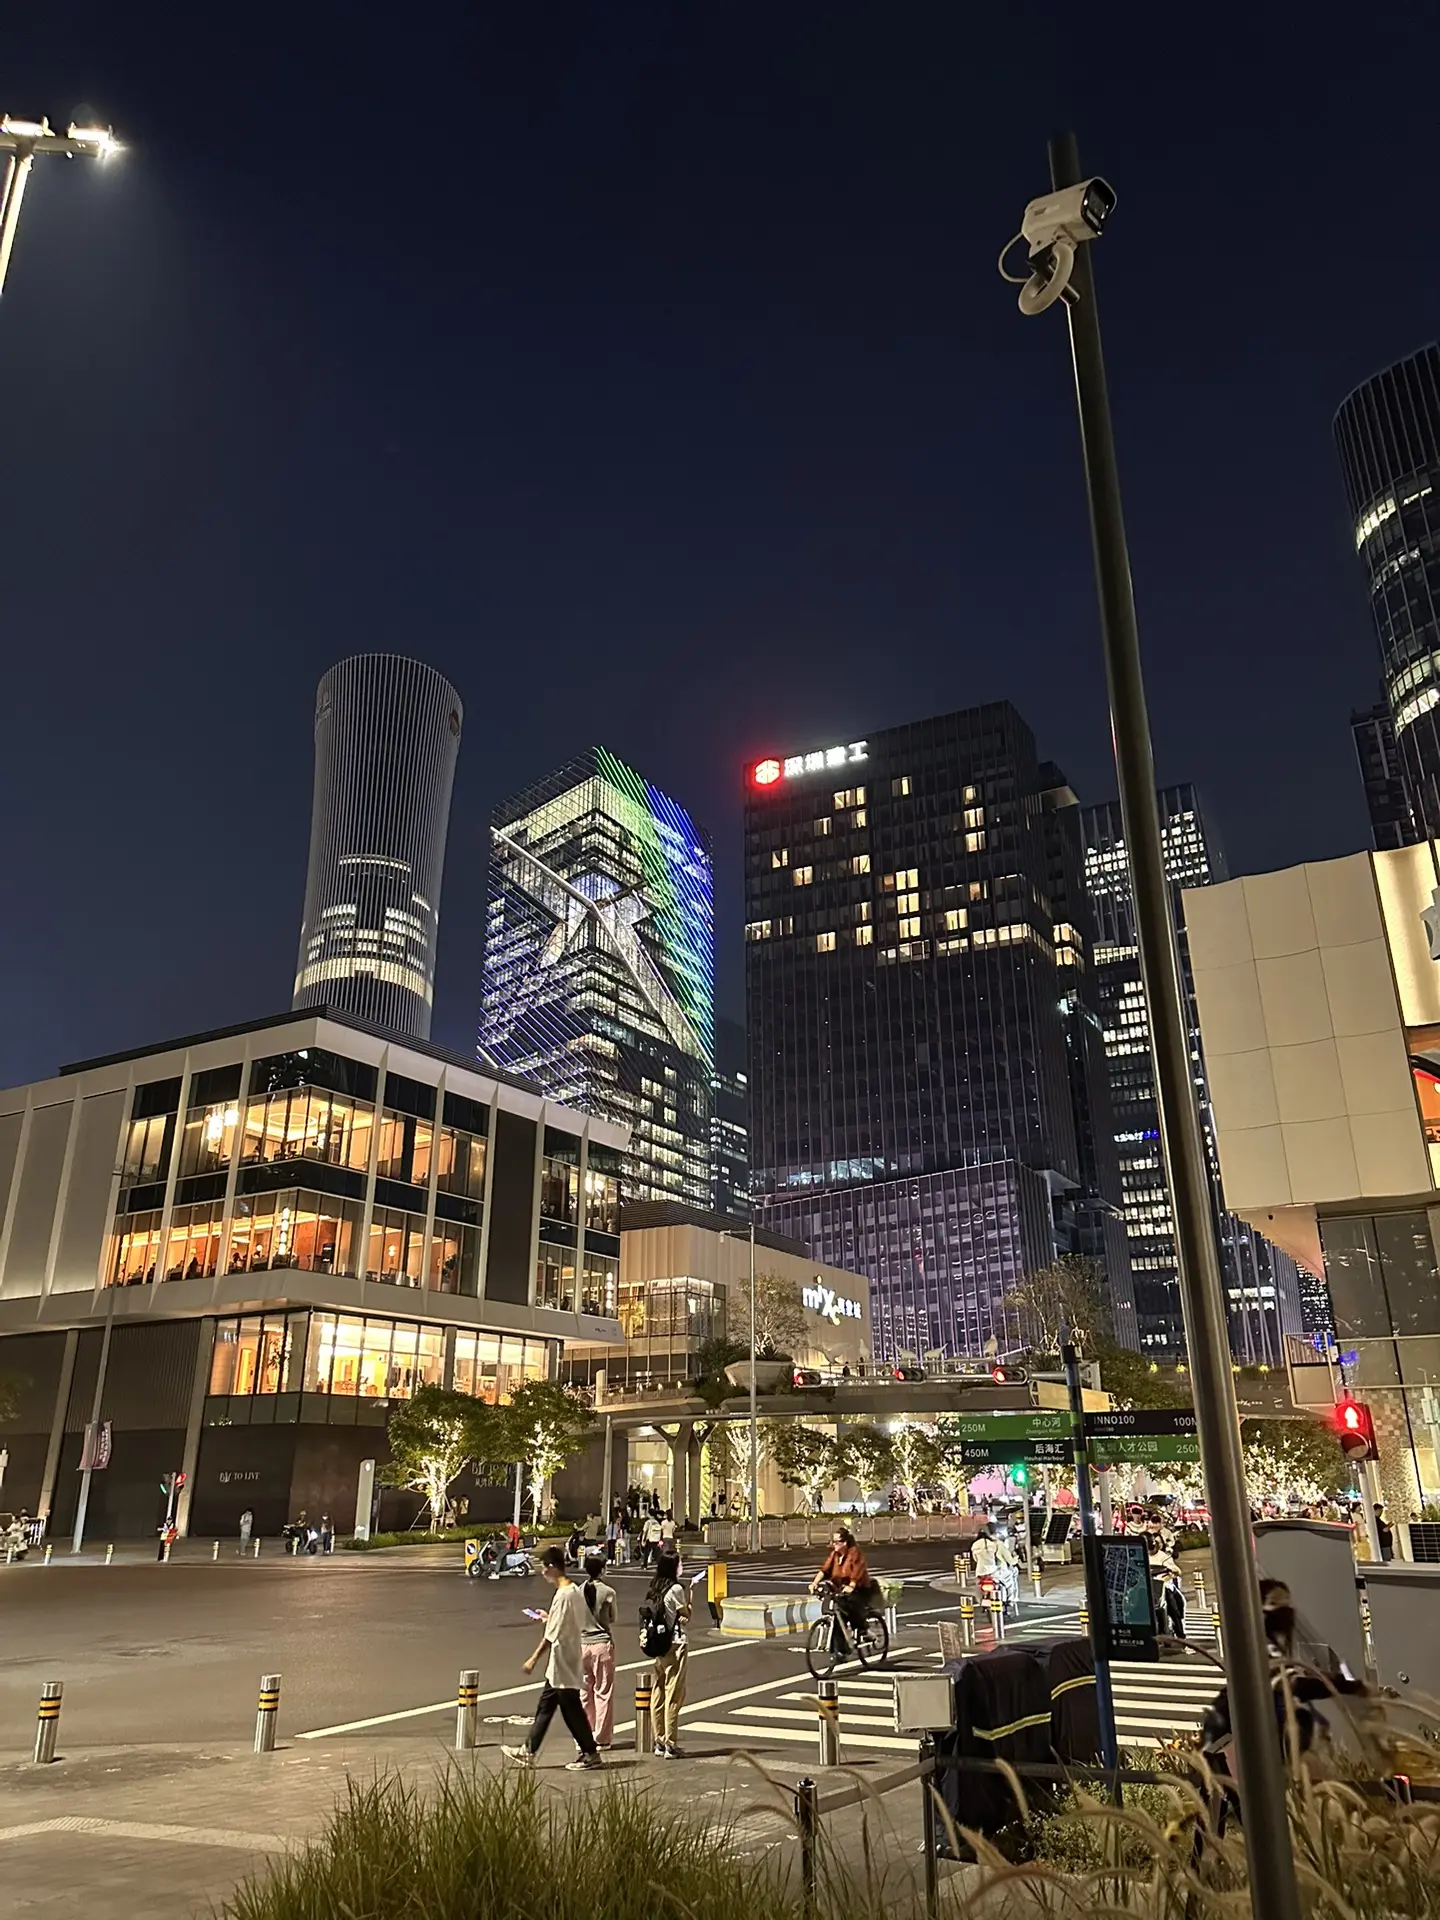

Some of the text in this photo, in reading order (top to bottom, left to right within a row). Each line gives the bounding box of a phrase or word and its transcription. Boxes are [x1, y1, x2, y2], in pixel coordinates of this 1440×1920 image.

[1032, 1417, 1061, 1428] 中心河
[1093, 1415, 1135, 1425] INNO100
[961, 1423, 986, 1433] 250M
[964, 1448, 989, 1458] 450M
[1035, 1443, 1065, 1454] 后海汇
